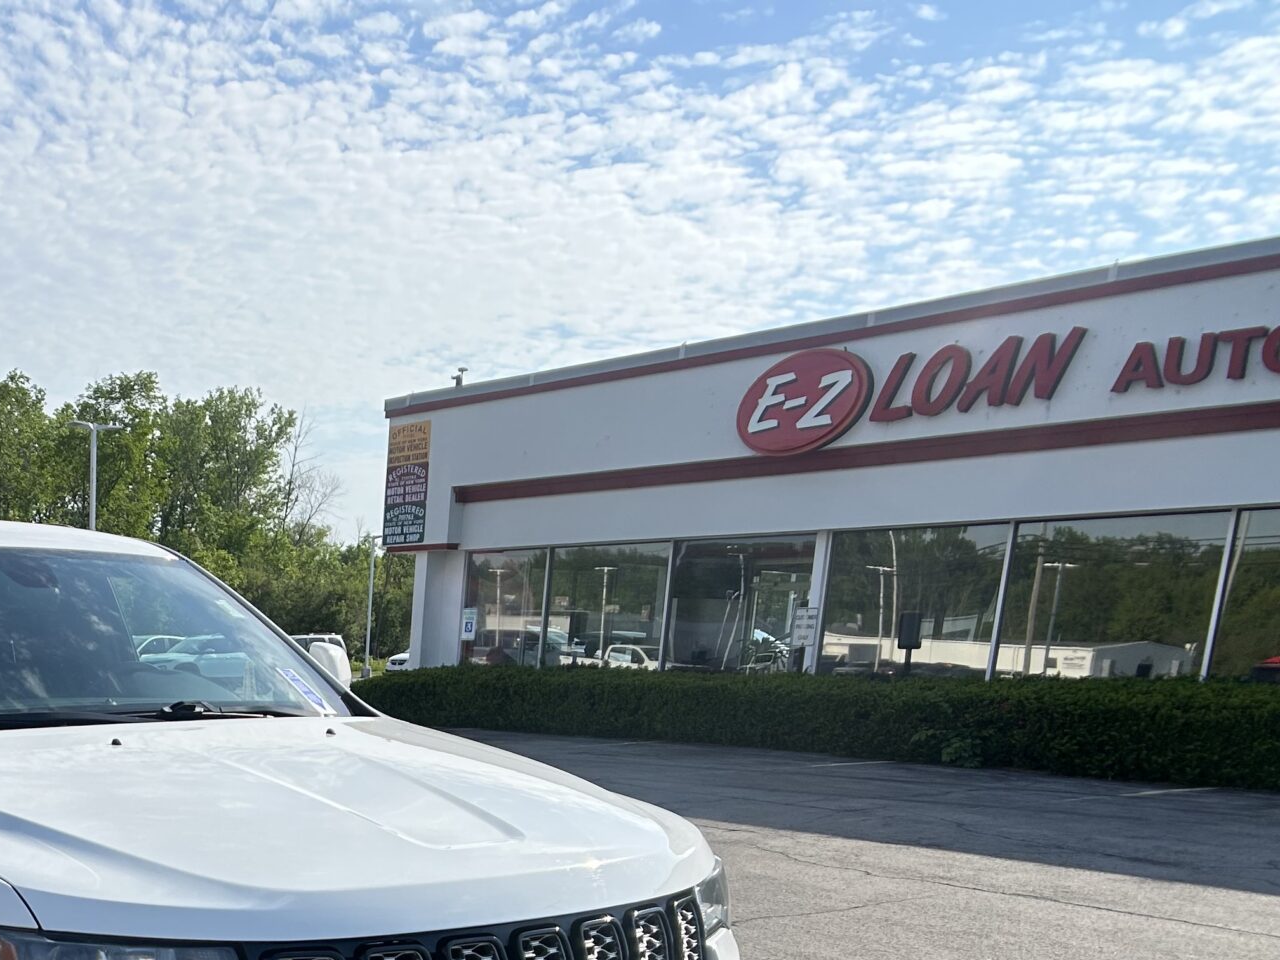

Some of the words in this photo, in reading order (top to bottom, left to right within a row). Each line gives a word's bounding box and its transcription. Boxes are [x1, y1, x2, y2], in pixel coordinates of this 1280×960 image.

[747, 369, 853, 435] E-Z
[868, 326, 1088, 423] LOAN
[392, 424, 427, 440] OFFICIAL
[390, 445, 406, 455] MOTOR
[407, 442, 428, 452] VEHICLE
[412, 452, 428, 462] STATION
[388, 464, 426, 482] REGISTERED
[387, 486, 404, 496] MOTOR
[405, 483, 426, 494] VEHICLE
[387, 494, 404, 504] RETAIL
[405, 492, 425, 502] DEALER
[386, 505, 425, 520] REGISTERED
[384, 526, 402, 535] MOTOR
[402, 524, 424, 534] VEHICLE
[386, 535, 405, 544] REPAIR
[405, 533, 420, 543] SHOP
